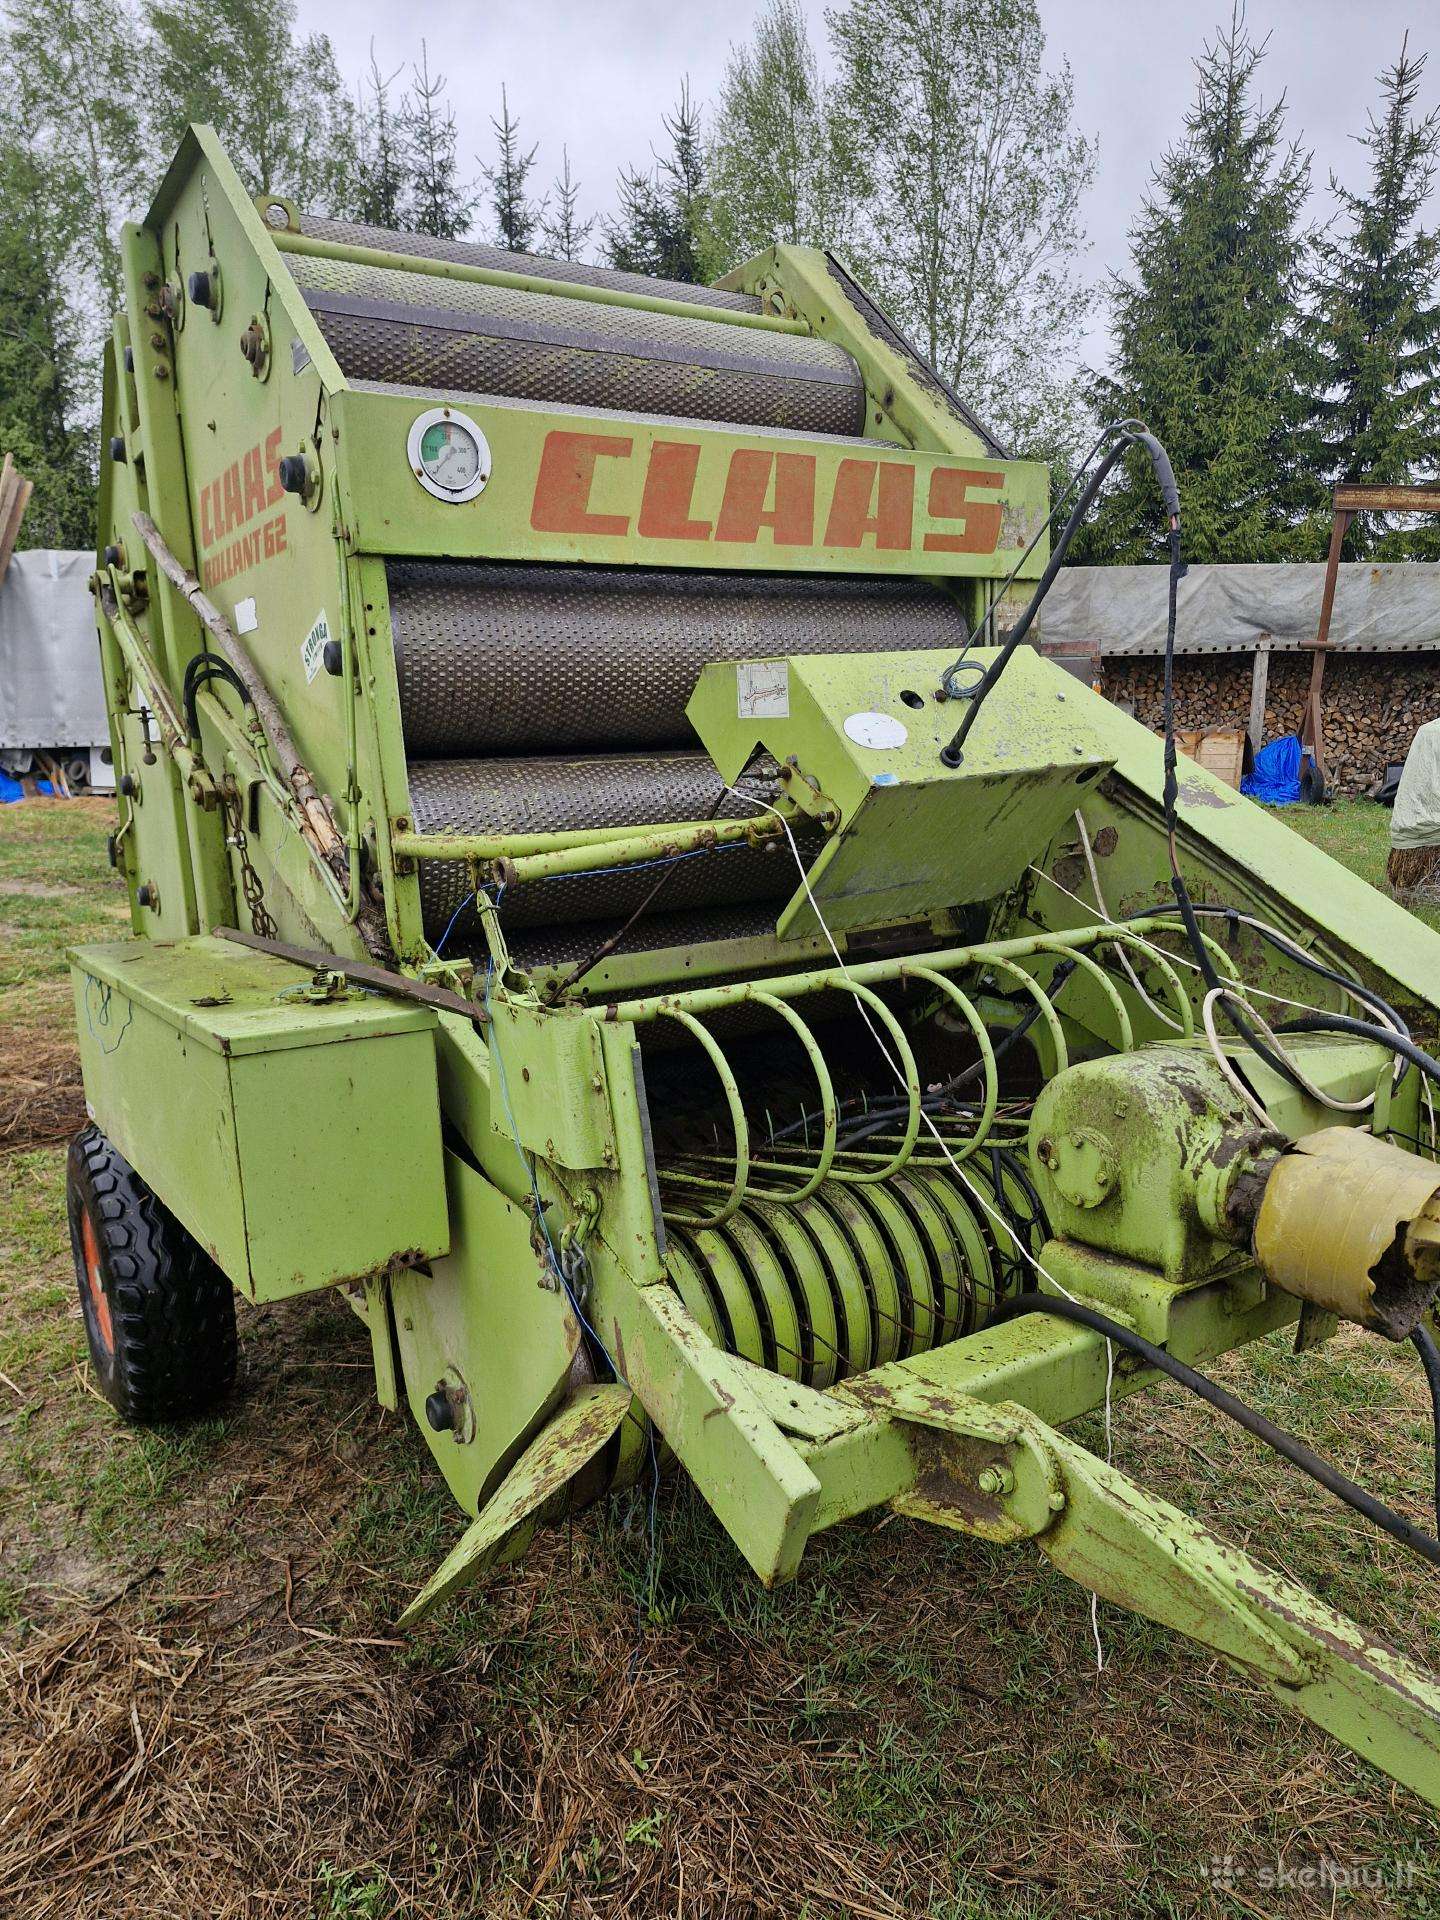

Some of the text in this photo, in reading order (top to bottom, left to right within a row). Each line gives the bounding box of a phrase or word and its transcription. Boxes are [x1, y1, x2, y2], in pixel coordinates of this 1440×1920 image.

[200, 426, 286, 550] CLAAS
[530, 430, 1006, 554] CLAAS
[204, 514, 288, 590] ROLLANT 62
[304, 622, 328, 667] STRONGA
